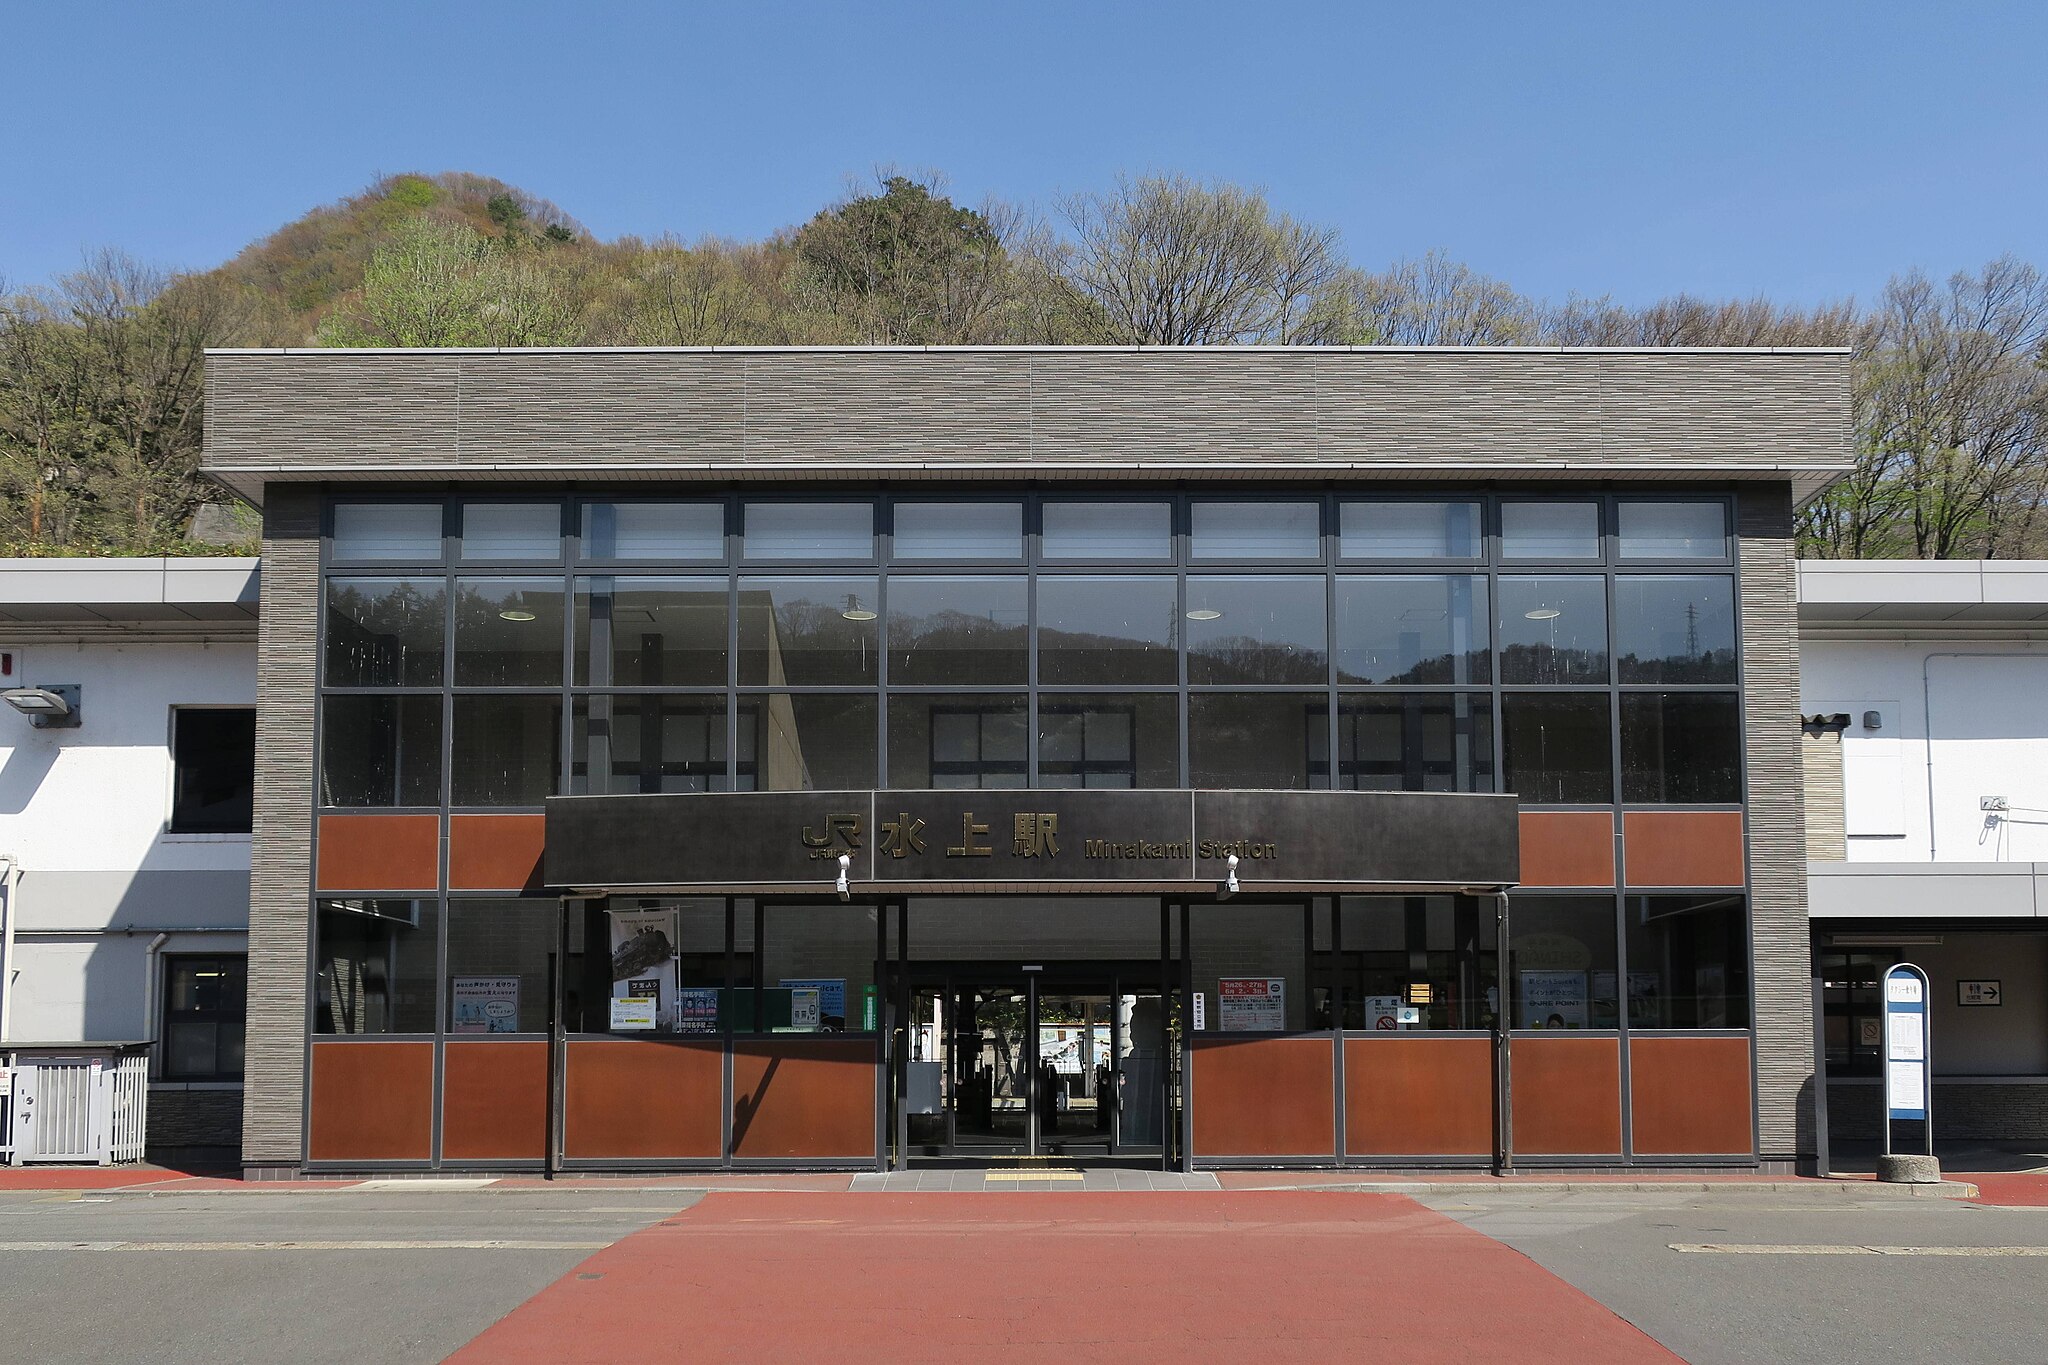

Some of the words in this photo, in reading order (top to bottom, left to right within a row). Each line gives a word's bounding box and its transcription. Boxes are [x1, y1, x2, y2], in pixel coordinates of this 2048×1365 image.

[802, 813, 863, 847] JR
[879, 812, 1060, 858] 水上駅
[1085, 838, 1191, 859] Minakami
[1198, 838, 1277, 859] Station
